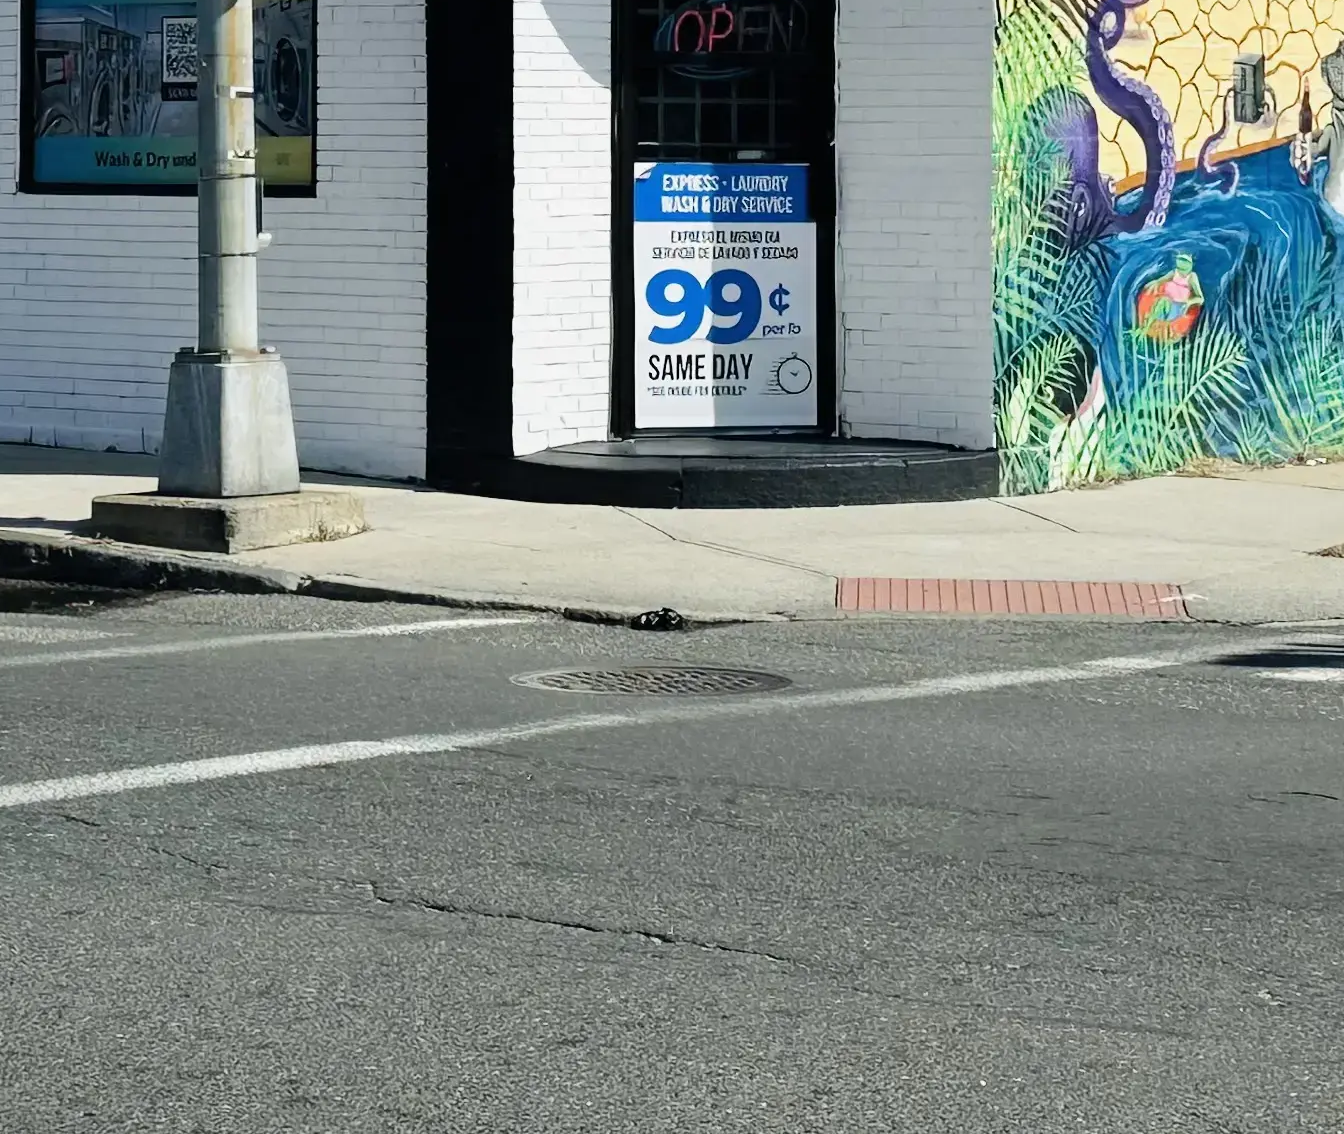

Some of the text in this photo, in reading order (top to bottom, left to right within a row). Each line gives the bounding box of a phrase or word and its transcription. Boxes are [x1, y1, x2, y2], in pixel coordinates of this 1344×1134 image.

[674, 3, 794, 53] OPEN
[95, 151, 130, 167] Wash
[133, 153, 143, 167] &
[146, 152, 169, 170] Dry
[663, 174, 788, 192] EXPRESS LAUNDRY
[661, 196, 698, 213] WASH
[713, 197, 738, 213] DRY
[741, 197, 793, 213] SERVICE
[645, 268, 762, 345] 99
[648, 354, 753, 380] SAME DAY
